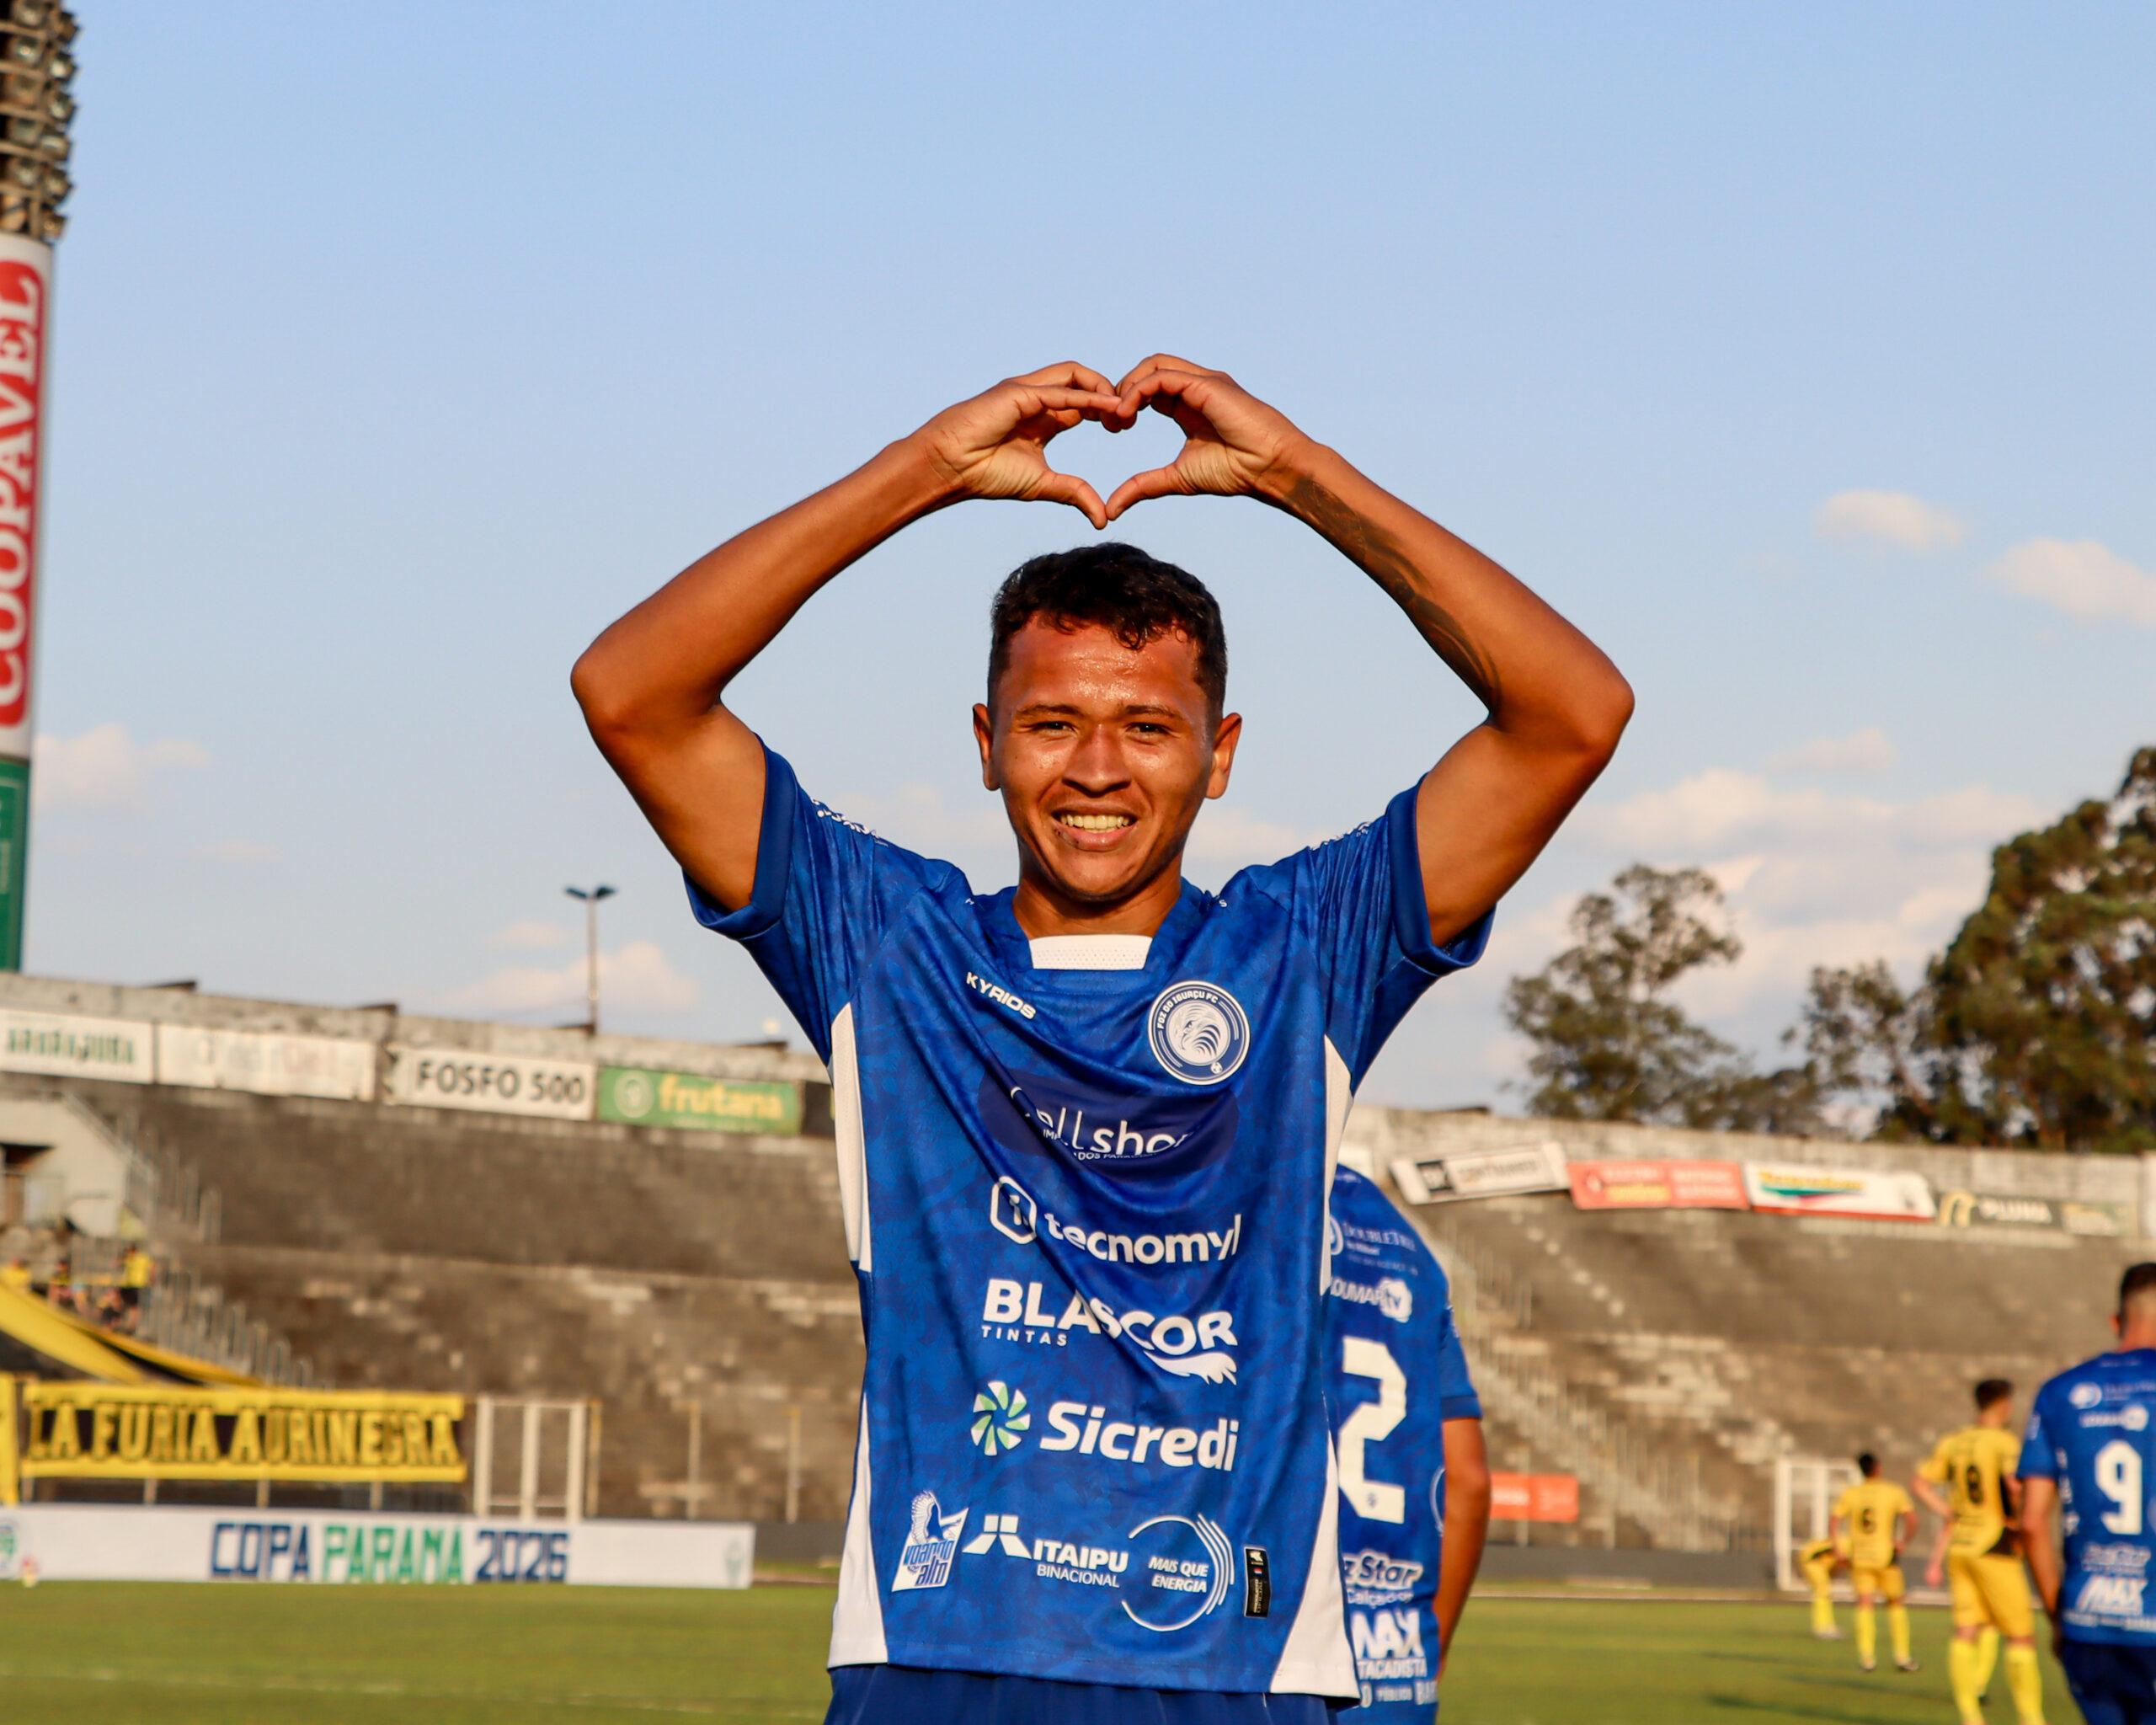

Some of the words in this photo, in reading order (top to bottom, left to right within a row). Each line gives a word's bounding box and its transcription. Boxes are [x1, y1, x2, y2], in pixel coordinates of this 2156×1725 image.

[966, 971, 1037, 1020] KYRIOS
[1157, 1011, 1167, 1029] FOZ
[1162, 1000, 1174, 1013] DO
[1206, 992, 1219, 1003] FC
[418, 1060, 520, 1098] FOSFO
[530, 1072, 585, 1105] 500
[1043, 1213, 1243, 1264] tecnomyl
[981, 1326, 1068, 1346] TINTAS
[983, 1278, 1239, 1356] BLASCOR
[28, 1401, 81, 1461] LA
[90, 1402, 221, 1464] FURIA
[1038, 1401, 1240, 1471] Sicredi
[1337, 1335, 1407, 1524] 2
[2095, 1439, 2143, 1535] 9
[211, 1522, 310, 1578] COPA
[474, 1529, 570, 1583] 2026
[1033, 1538, 1129, 1573] ITAIPU
[1037, 1563, 1119, 1589] BINACIONAL
[1148, 1556, 1178, 1573] MAIS
[1180, 1561, 1209, 1578] QUE
[1151, 1573, 1207, 1594] ENERGIA
